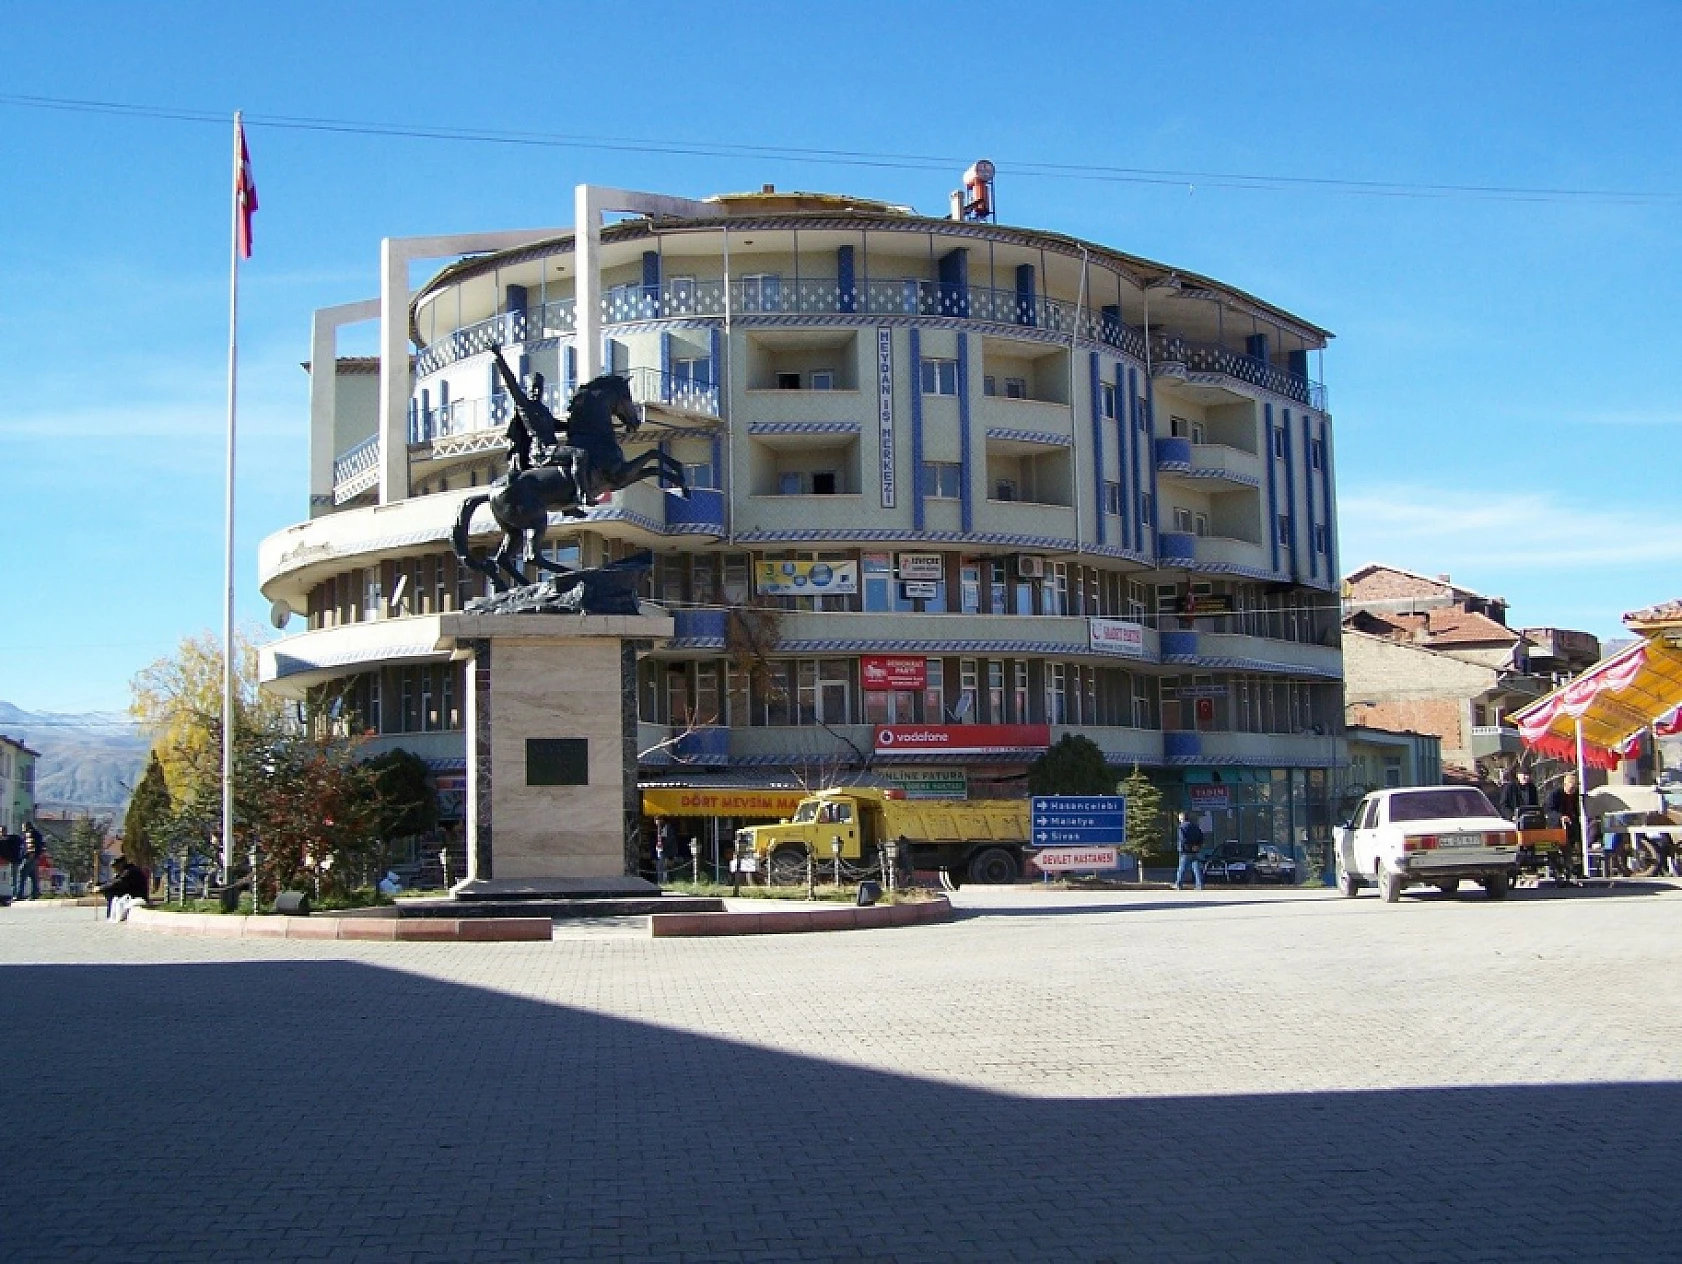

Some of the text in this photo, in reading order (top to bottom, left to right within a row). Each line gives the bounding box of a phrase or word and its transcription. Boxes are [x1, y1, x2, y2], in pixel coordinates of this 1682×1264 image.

[896, 731, 949, 742] vodafone
[681, 795, 719, 808] DÖRT
[776, 798, 802, 810] MA
[1051, 801, 1117, 812] Hasançelebi
[1051, 817, 1095, 827] Malatya
[1051, 831, 1080, 841] Sivas
[1042, 854, 1071, 865] DEVLET
